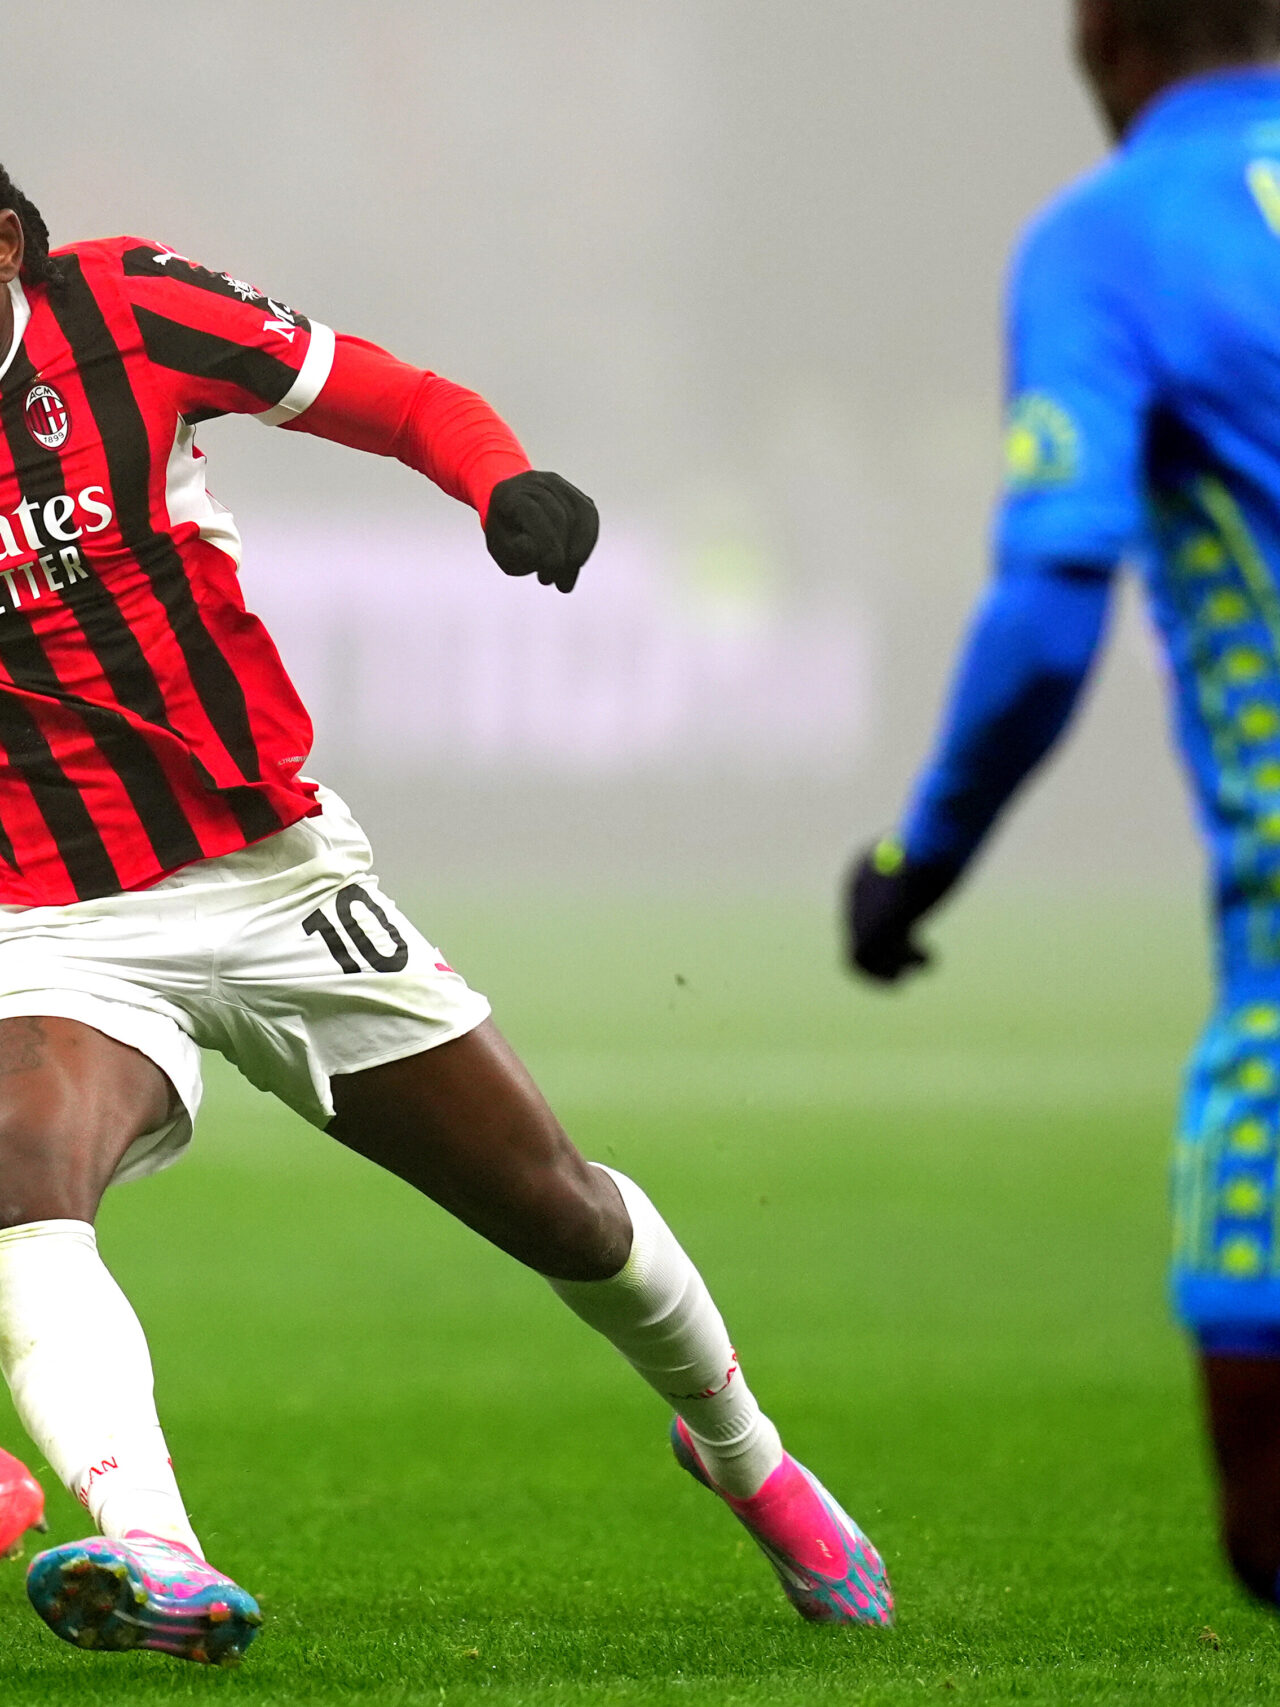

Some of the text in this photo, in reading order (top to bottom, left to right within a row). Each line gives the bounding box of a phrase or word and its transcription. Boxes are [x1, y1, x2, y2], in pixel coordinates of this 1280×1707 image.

[29, 386, 54, 402] ACM
[43, 431, 66, 444] 1899
[302, 883, 409, 975] 10
